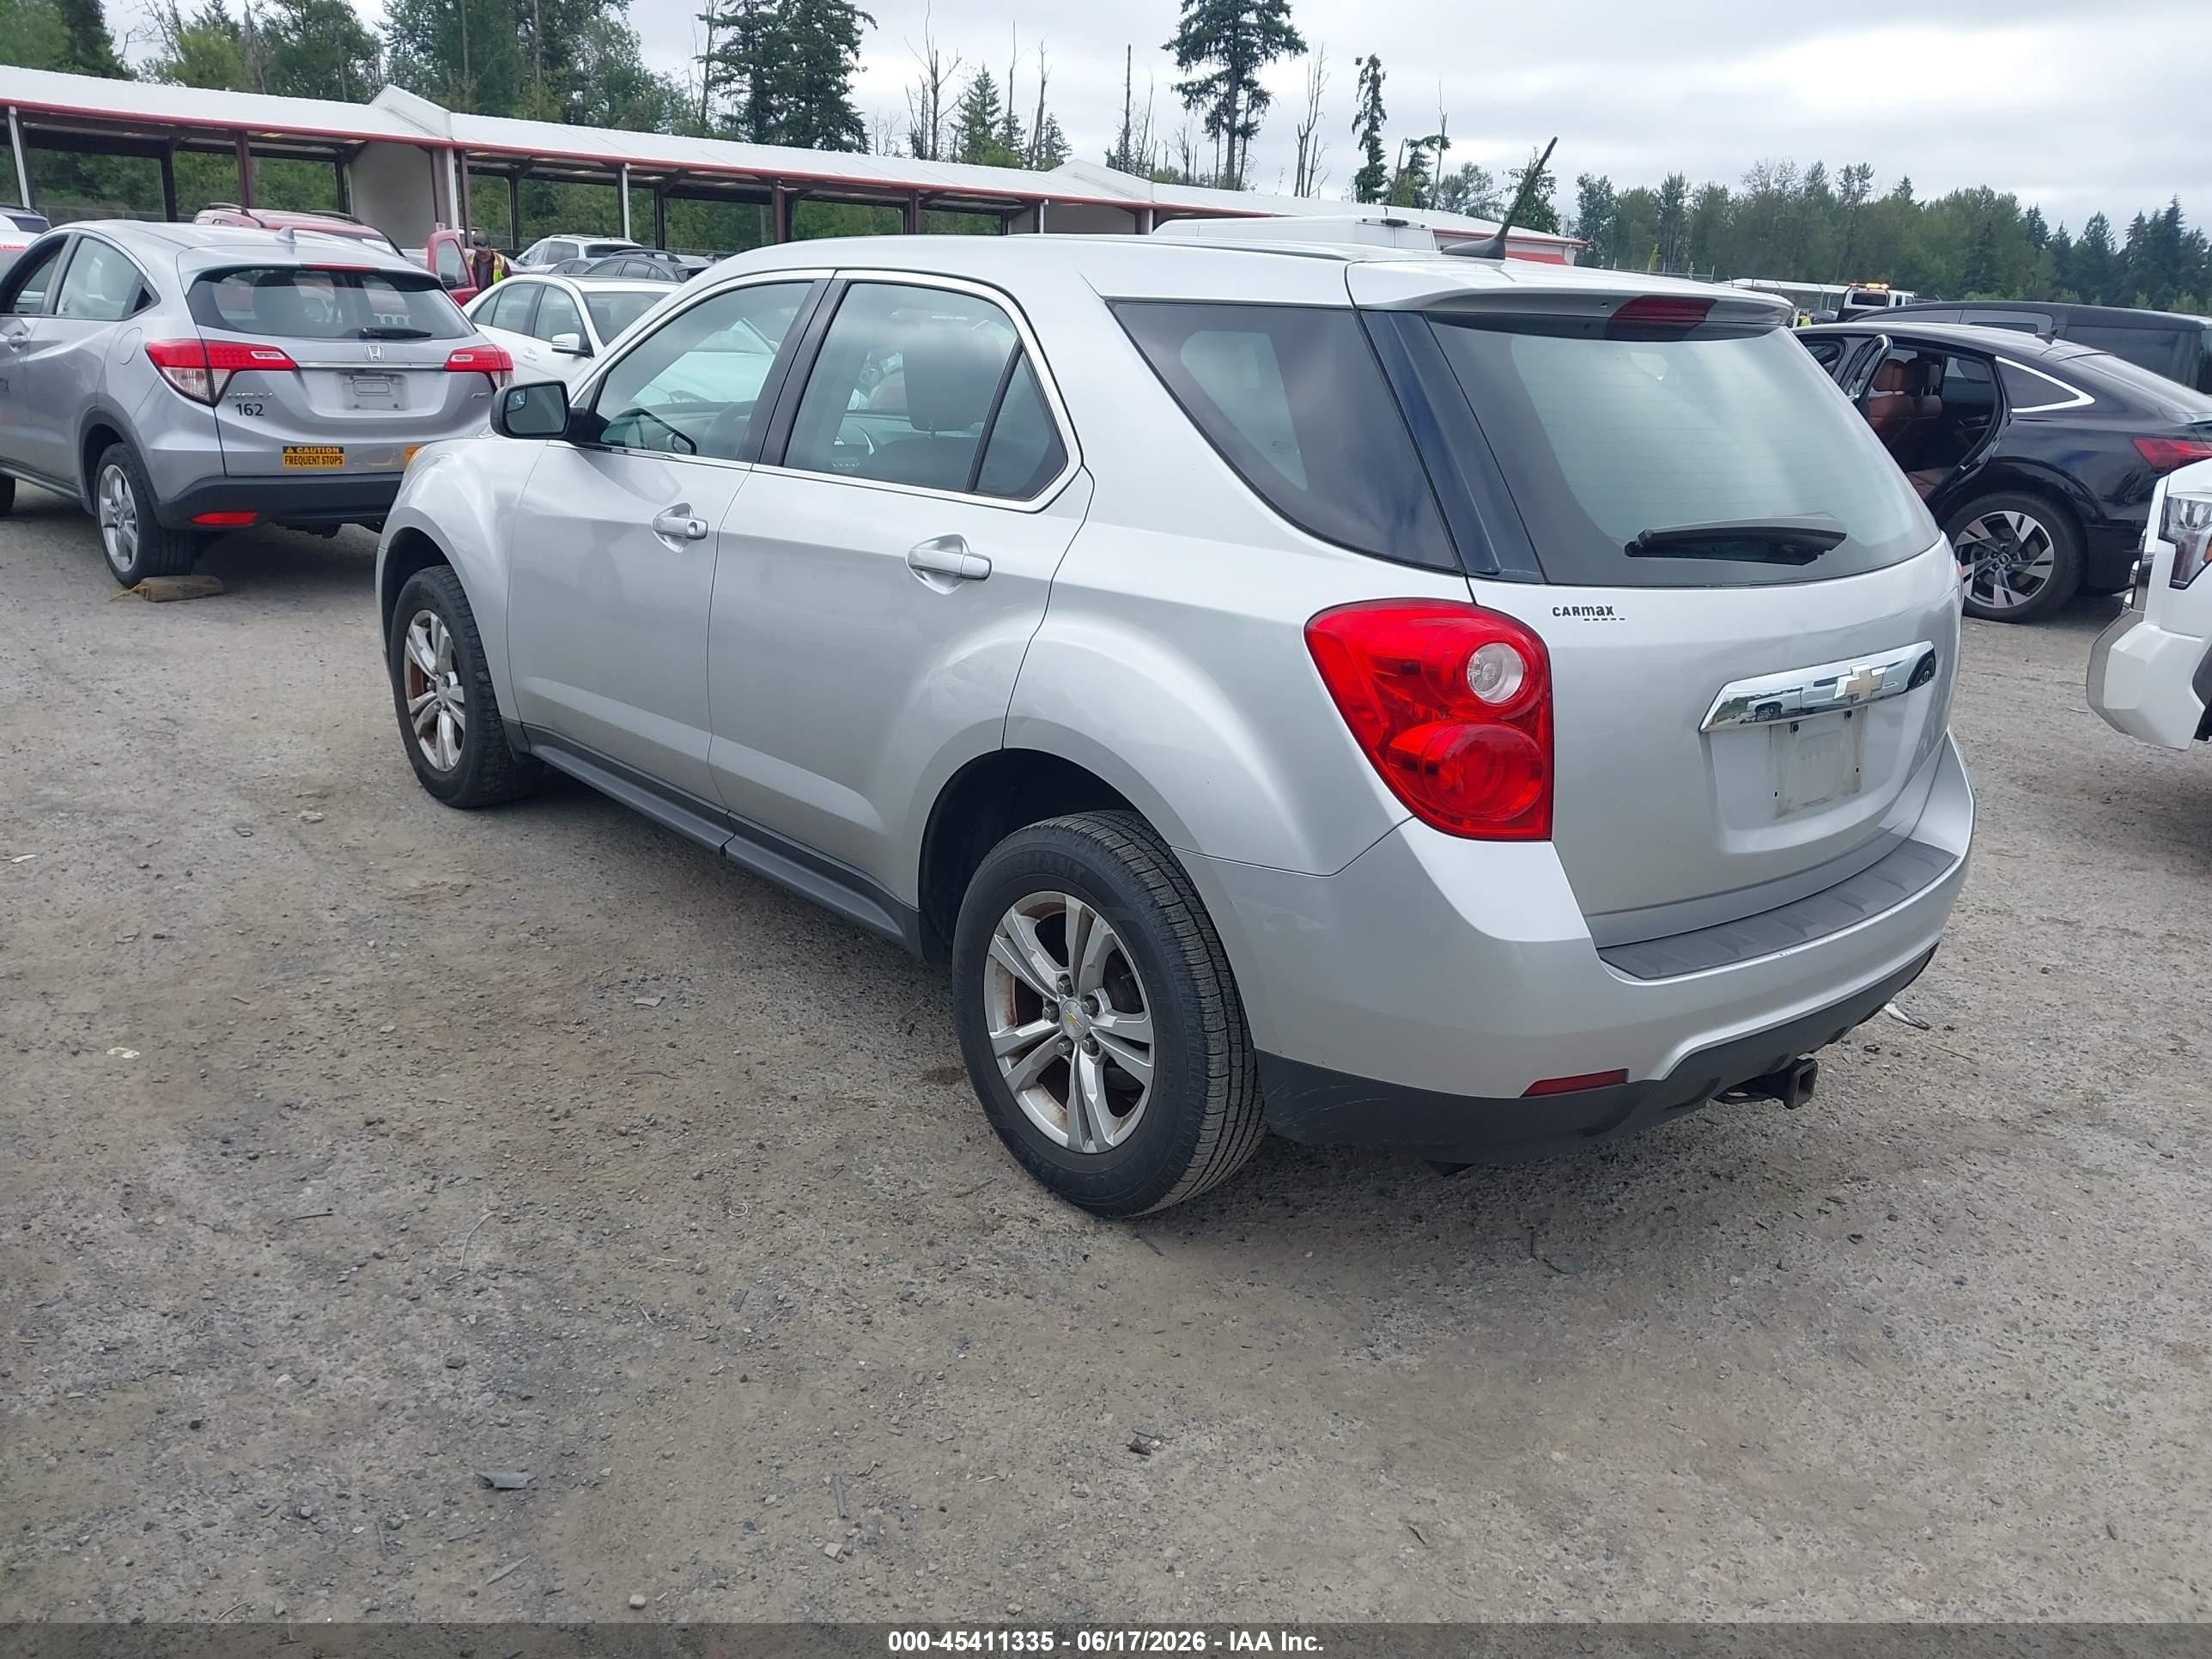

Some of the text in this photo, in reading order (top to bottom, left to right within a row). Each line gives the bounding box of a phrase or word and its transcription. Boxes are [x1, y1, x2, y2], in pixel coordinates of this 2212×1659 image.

[235, 403, 264, 416] 162
[284, 455, 343, 466] FREQUENT STOPS
